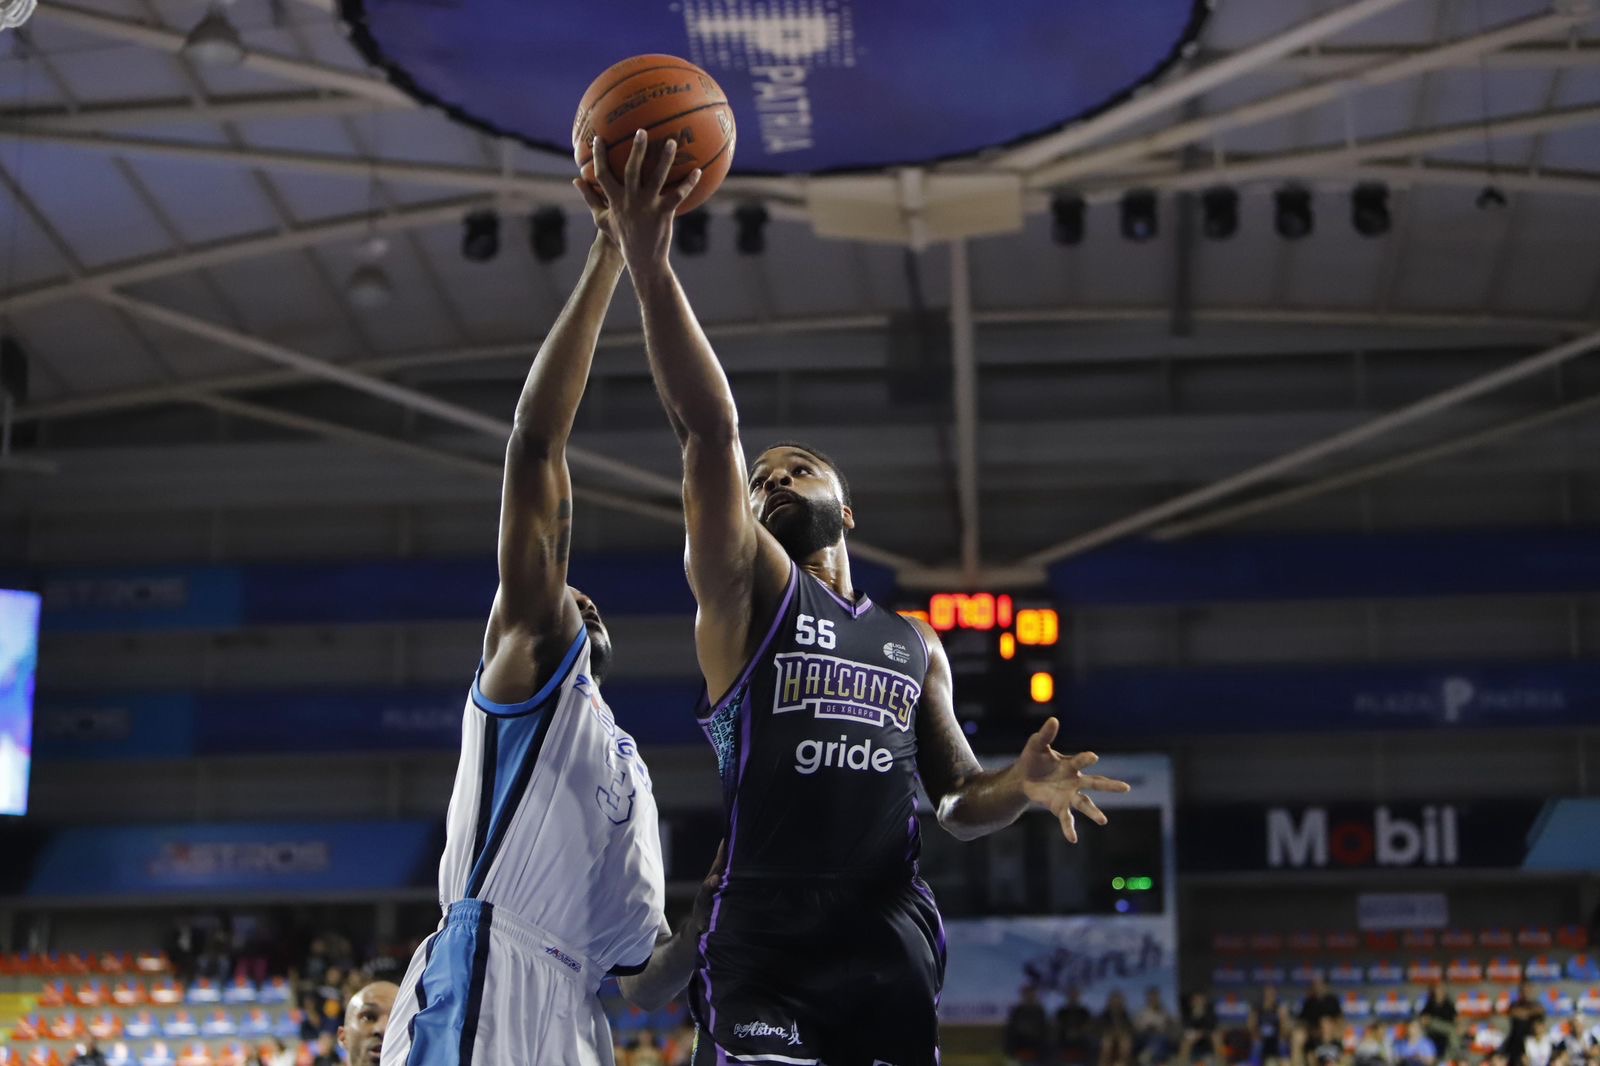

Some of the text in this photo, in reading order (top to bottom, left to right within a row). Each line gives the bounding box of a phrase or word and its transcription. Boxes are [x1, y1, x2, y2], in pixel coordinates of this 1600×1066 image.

[751, 64, 814, 154] PATRIA
[795, 613, 837, 650] 55
[892, 642, 906, 651] LIGA
[783, 660, 919, 724] HALCONES
[826, 703, 875, 719] DE XALAPA
[794, 734, 894, 775] gride
[1266, 804, 1459, 868] Mobil
